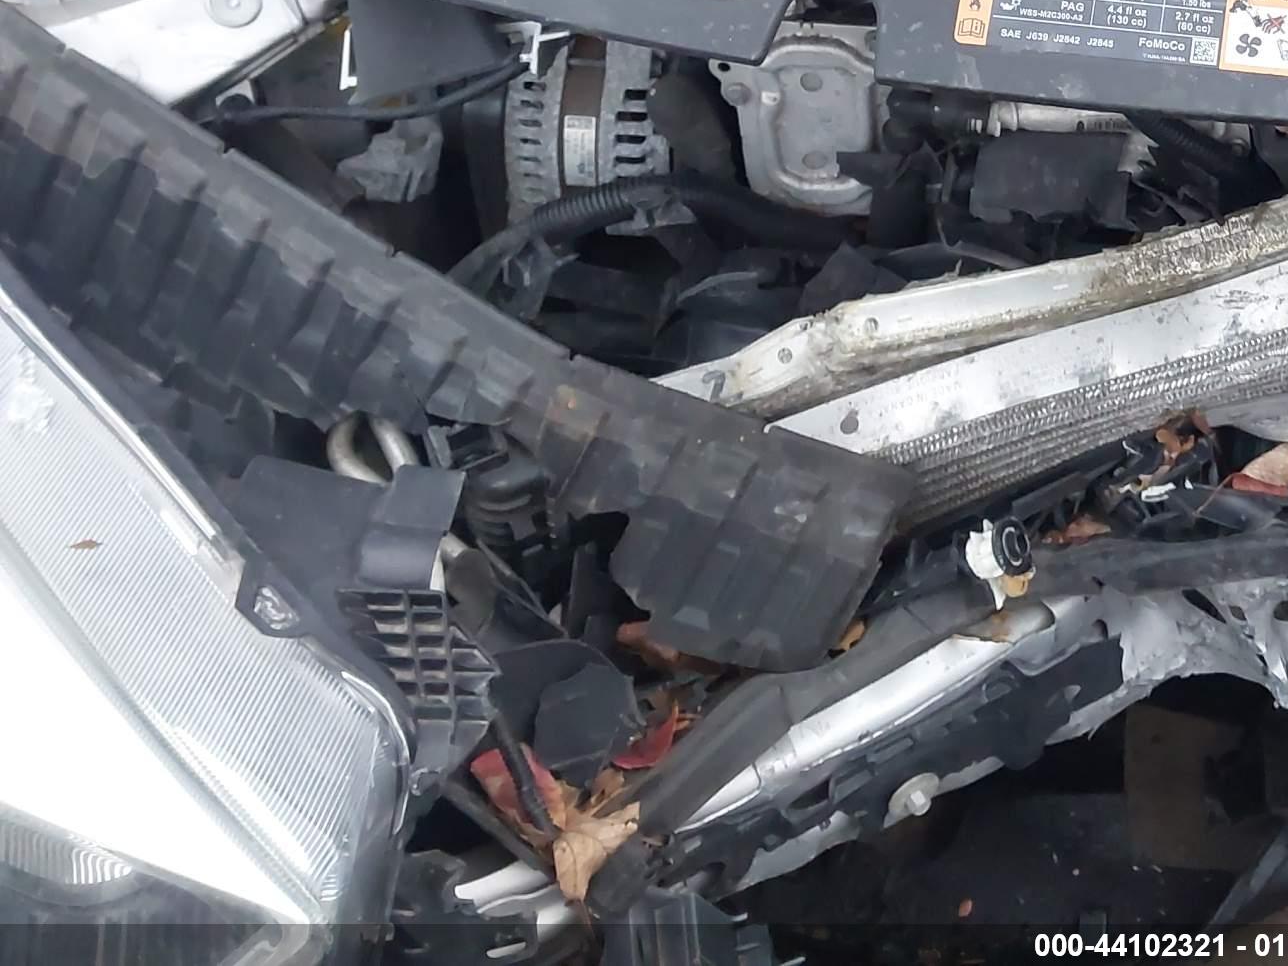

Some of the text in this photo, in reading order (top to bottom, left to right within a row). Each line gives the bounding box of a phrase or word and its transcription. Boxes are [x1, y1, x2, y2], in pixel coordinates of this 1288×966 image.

[1061, 1, 1085, 11] PAG
[1200, 0, 1211, 8] lbs
[1108, 5, 1122, 14] 4.4
[1126, 6, 1132, 15] fl
[1107, 14, 1147, 28] (130 cc)
[1175, 12, 1214, 24] 2.7 fl oz
[1196, 24, 1211, 34] cc)
[1000, 29, 1021, 39] SAE
[1026, 32, 1048, 41] J639
[1139, 37, 1185, 51] FoMoCo
